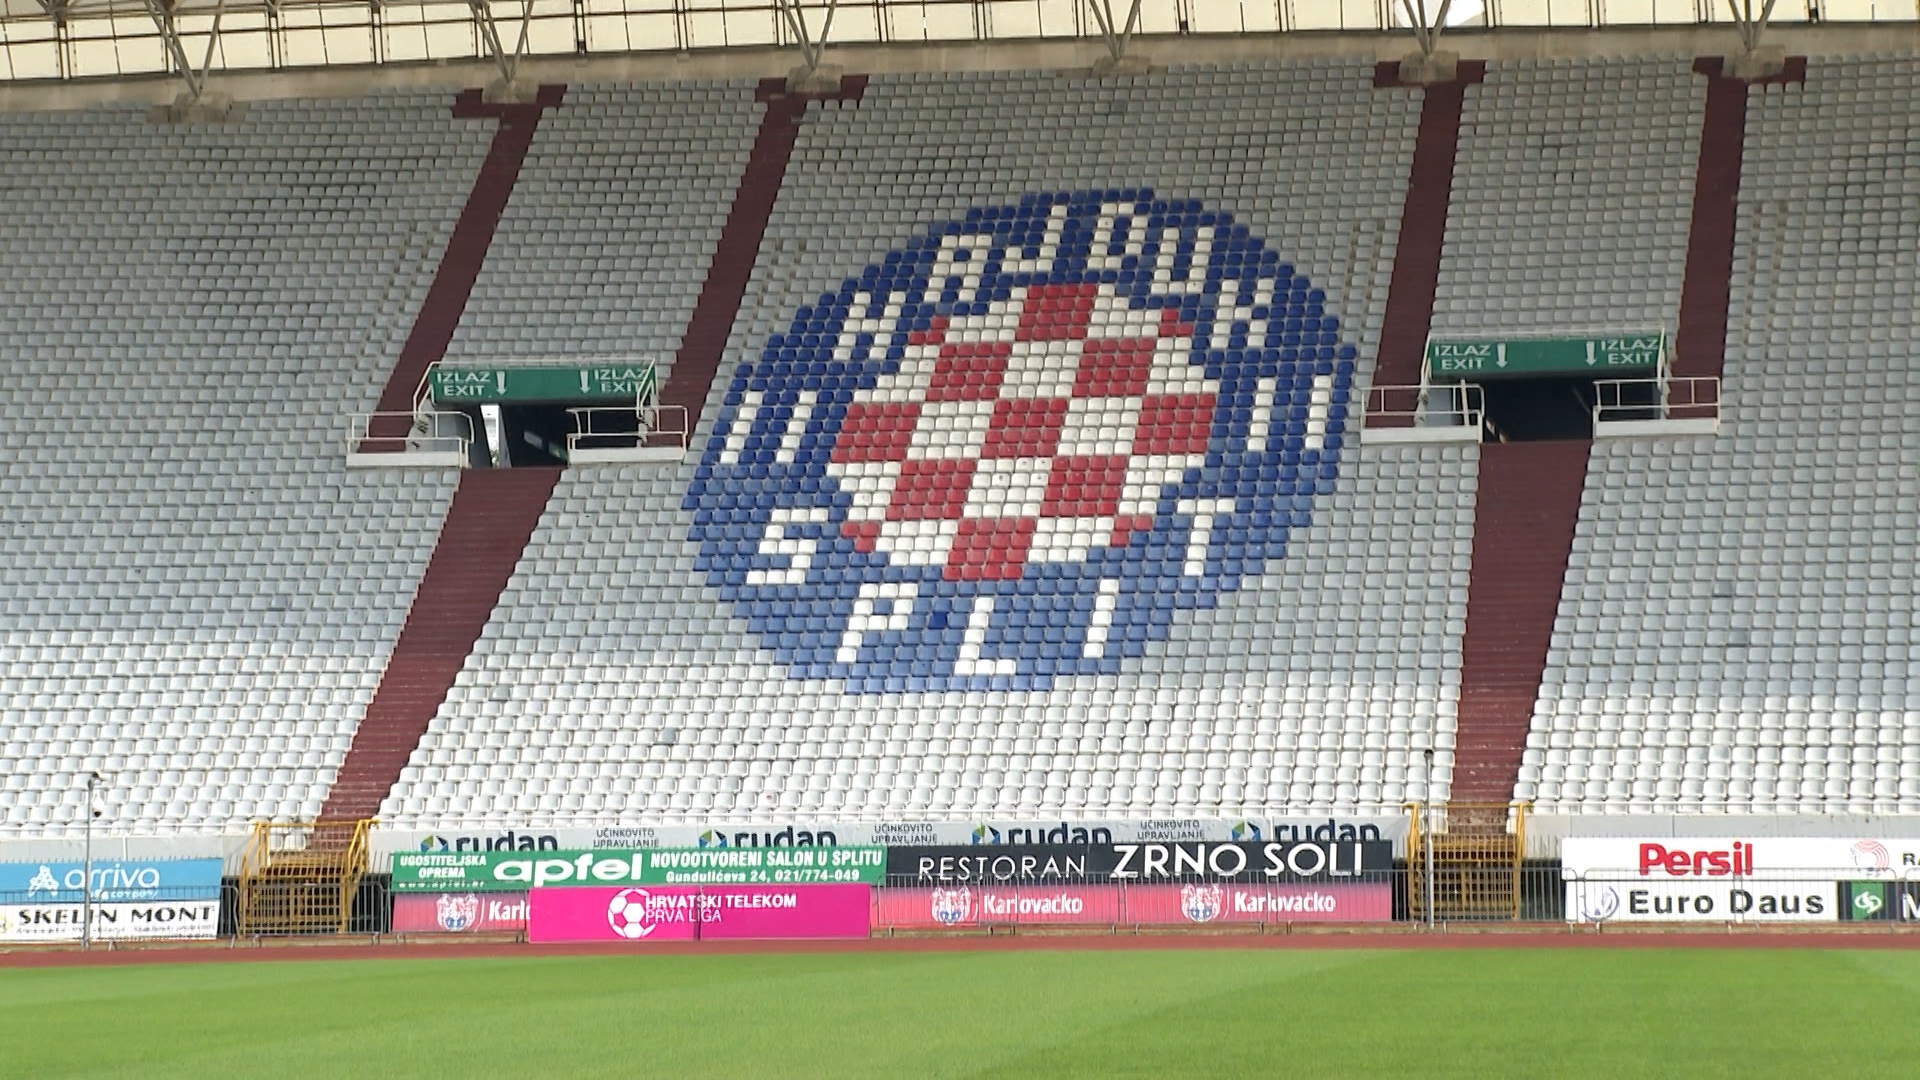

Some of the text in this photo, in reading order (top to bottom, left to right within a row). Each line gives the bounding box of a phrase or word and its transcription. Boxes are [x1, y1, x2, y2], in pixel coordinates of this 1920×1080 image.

[832, 203, 1277, 360] HAJDUK
[1435, 345, 1491, 357] IZLAZ
[1601, 338, 1658, 351] IZLAZ
[1441, 358, 1485, 370] EXIT
[1607, 352, 1652, 364] EXIT
[437, 372, 490, 383] IZLAZ
[594, 368, 649, 380] IZLAZ
[444, 385, 485, 397] EXIT
[601, 382, 642, 393] EXIT
[746, 499, 1242, 676] SPLIT
[874, 823, 933, 834] UČINKOVITO
[1140, 819, 1200, 830] UČINKOVITO
[1275, 818, 1380, 841] rudan
[596, 828, 655, 838] UČINKOVITO
[734, 826, 837, 847] rudan
[871, 834, 938, 844] UPRAVLJANJE
[1008, 822, 1112, 844] rudan
[1137, 829, 1204, 840] UPRAVLJANJE
[456, 831, 559, 851] rudan
[593, 838, 659, 848] UPRAVLJANJE
[400, 855, 487, 867] UGOSTITELJSKA
[650, 850, 883, 868] NOVOOTVORENI SALON U SPLITU
[919, 843, 1362, 881] RESTORAN ZRNO SOLI
[1639, 841, 1753, 876] Persil
[64, 863, 160, 888] arriva
[418, 867, 466, 878] OPREMA
[493, 853, 643, 887] apfel
[666, 869, 860, 883] Gundulićeva 24, 021/774-049
[645, 894, 797, 909] HRVATSKI TELEKOM
[984, 893, 1083, 914] Karlovačko
[1235, 891, 1336, 912] Karlovačko
[1629, 889, 1824, 914] Euro Daus
[19, 905, 215, 925] SKELIN MONT
[645, 909, 722, 923] PRVA LIGA
